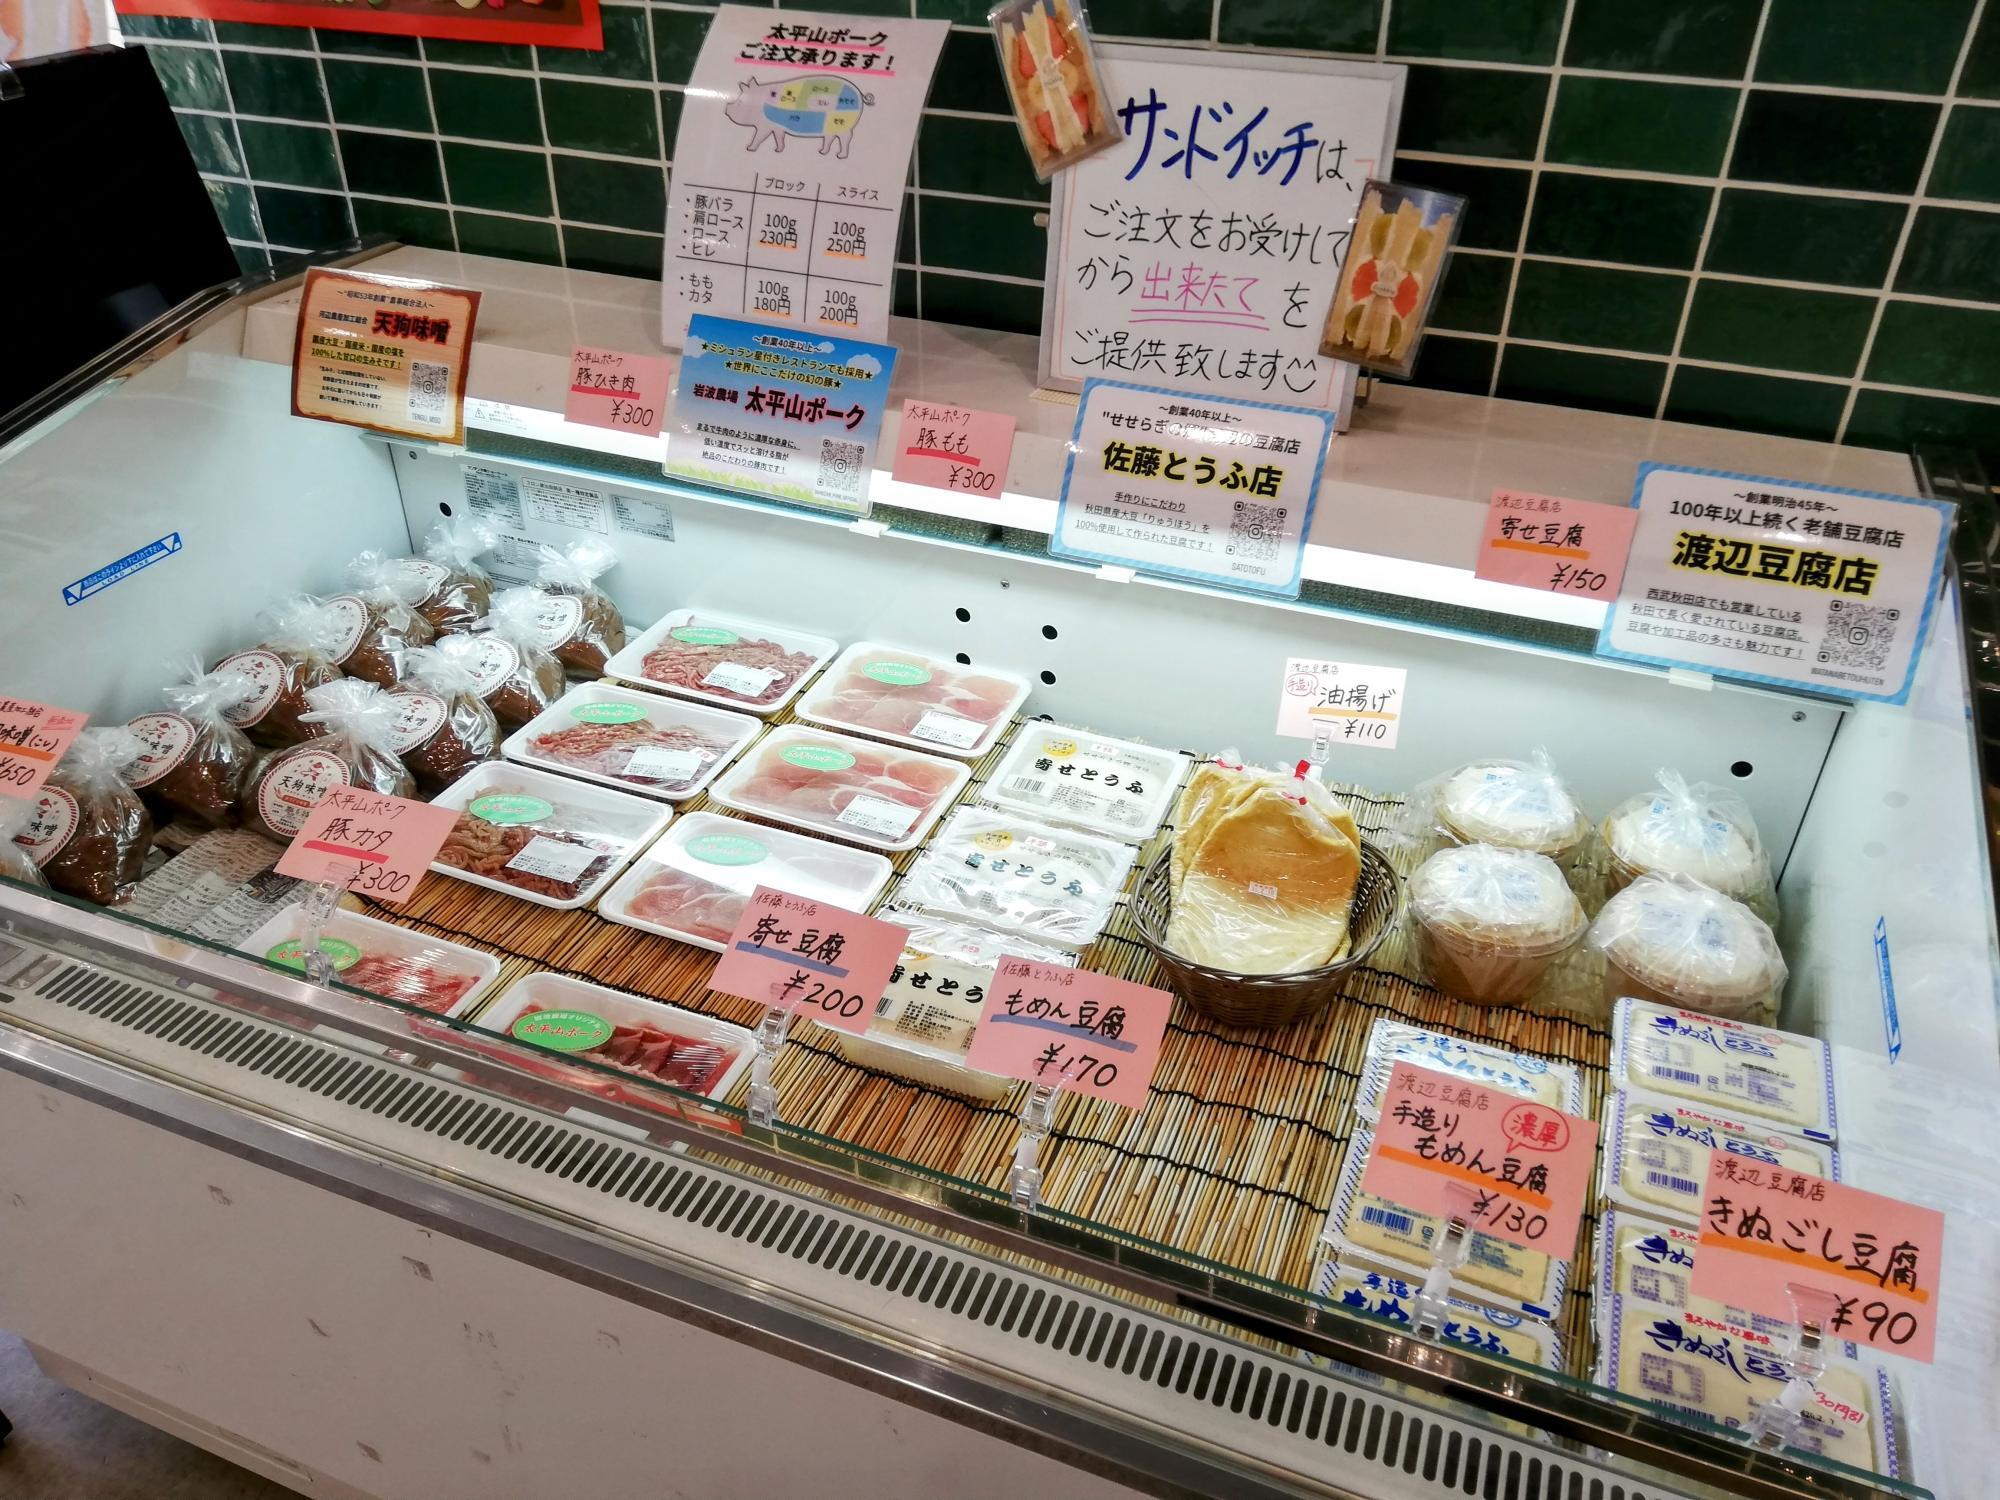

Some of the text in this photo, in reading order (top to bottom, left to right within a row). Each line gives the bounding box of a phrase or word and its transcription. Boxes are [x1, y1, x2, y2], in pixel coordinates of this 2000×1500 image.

[768, 23, 889, 47] 太平山ポーク
[740, 42, 895, 70] ご注文承ります！
[764, 177, 880, 201] ブロック スライス
[764, 213, 866, 241] 100g 100g
[1084, 200, 1349, 268] ご注文をお受けして
[759, 230, 867, 257] 230円 250円
[757, 280, 857, 310] 100g 100g
[753, 297, 859, 325] 180円 200円
[372, 310, 451, 345] 天狗味噌
[574, 350, 623, 367] 太平山ポーク
[576, 367, 635, 393] 豚ひき肉
[611, 399, 654, 427] ¥300
[693, 383, 866, 430] 岩波農場 太平山ポーク
[907, 405, 971, 426] 太平山ポーク
[916, 427, 969, 454] 豚もも
[949, 465, 995, 490] ¥300
[1104, 441, 1283, 497] 佐藤とうふ店
[1114, 491, 1186, 513] 手作りにこだわり
[1501, 515, 1585, 548] 寄せ豆腐
[1231, 562, 1266, 576] SATOTOFU
[1550, 562, 1607, 591] ¥150
[1672, 531, 1880, 596] 渡辺豆腐店
[1646, 587, 1802, 624] 西武秋田店でも営業している
[1317, 684, 1397, 713] 油揚げ
[1344, 719, 1387, 740] ¥110
[321, 790, 407, 820] 太平山ポーク
[318, 818, 392, 852] 豚カタ
[347, 860, 410, 892] ¥300
[755, 891, 817, 916] 佐藤とうふ店
[748, 914, 846, 965] 寄せ豆腐
[1002, 961, 1075, 986] 佐藤とうふ店
[780, 969, 864, 1018] ¥200
[1005, 989, 1126, 1040] もめん豆腐
[1725, 1038, 1776, 1057] とうふ
[1035, 1042, 1118, 1087] ¥170
[1396, 1072, 1489, 1111] 渡辺豆腐店
[1392, 1100, 1561, 1148] 手造り 濃厚
[1415, 1134, 1549, 1194] もめん豆腐
[1724, 1139, 1780, 1165] とうふ
[1715, 1158, 1827, 1202] 渡辺豆腐店
[1471, 1188, 1548, 1240] ¥130
[1707, 1196, 1920, 1293] きぬごし豆腐
[1831, 1294, 1918, 1345] ¥90
